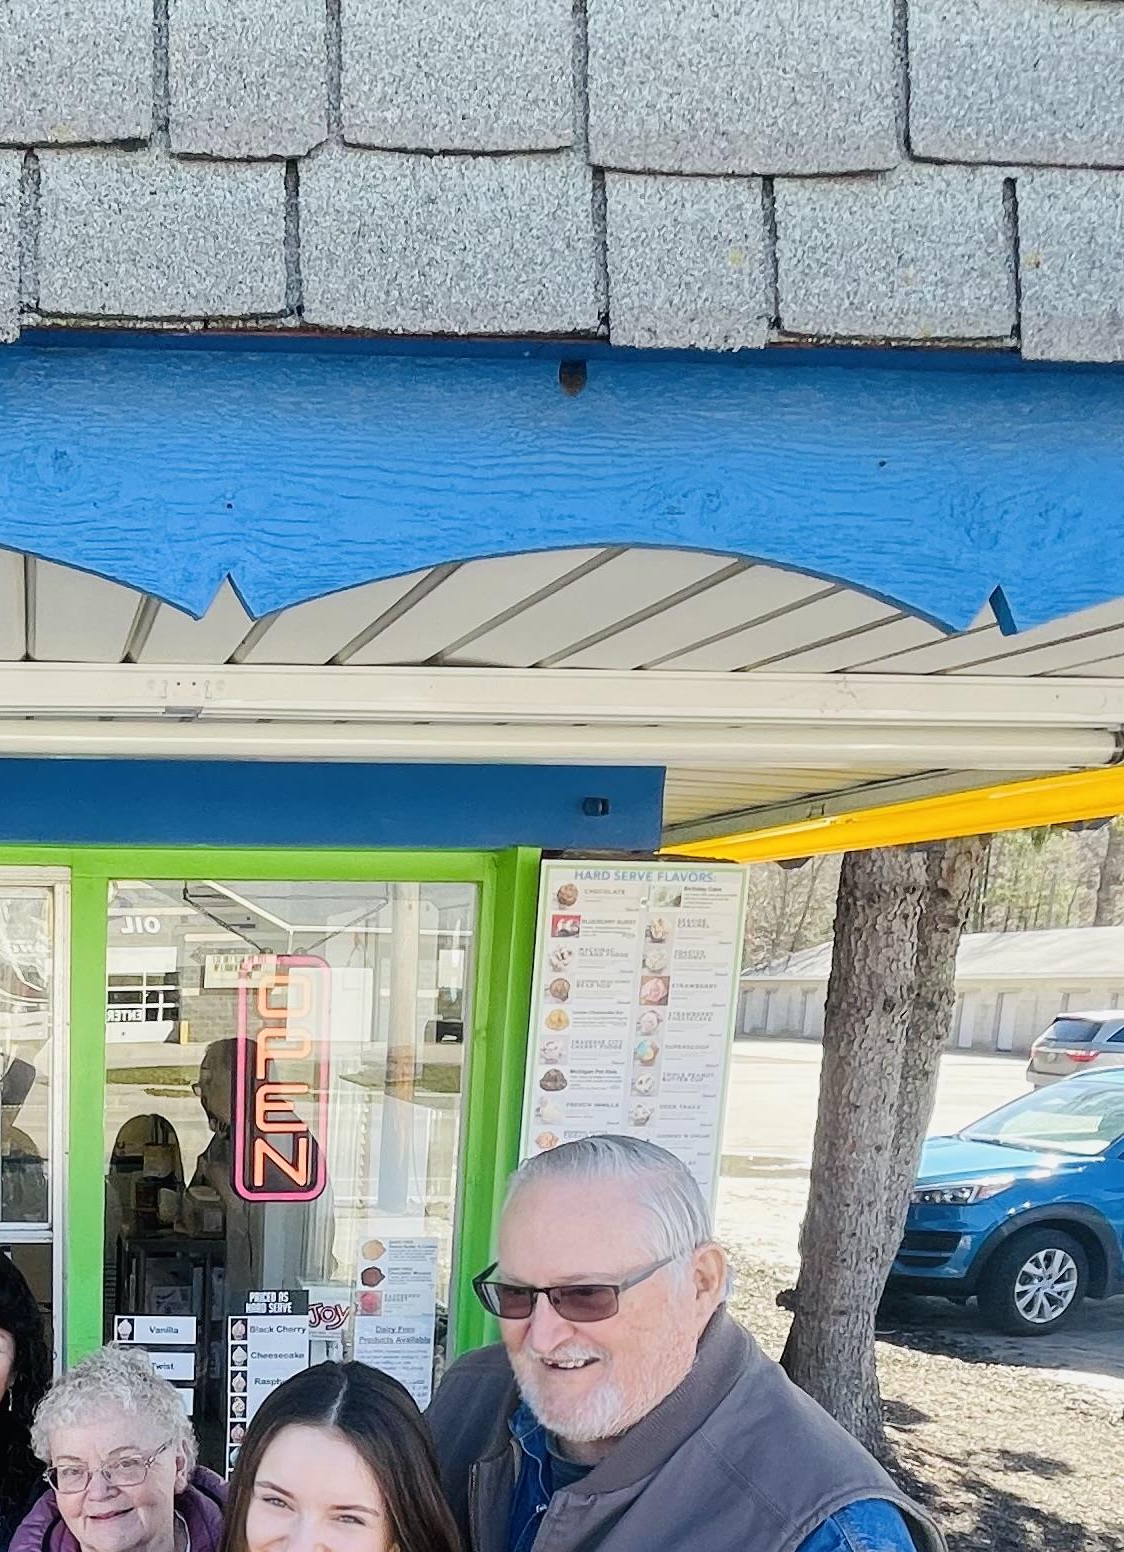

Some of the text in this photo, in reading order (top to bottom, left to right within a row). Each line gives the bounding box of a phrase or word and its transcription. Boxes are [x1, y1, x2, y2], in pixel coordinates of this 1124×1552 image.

[574, 870, 611, 881] HARD
[614, 870, 653, 882] SERVE
[254, 974, 311, 1187] OPEN
[249, 1291, 289, 1303] PRICED AS
[268, 1302, 293, 1314] SERVE
[149, 1325, 179, 1335] Vanilla
[249, 1325, 306, 1334] Black Cherry
[152, 1363, 175, 1371] Twist
